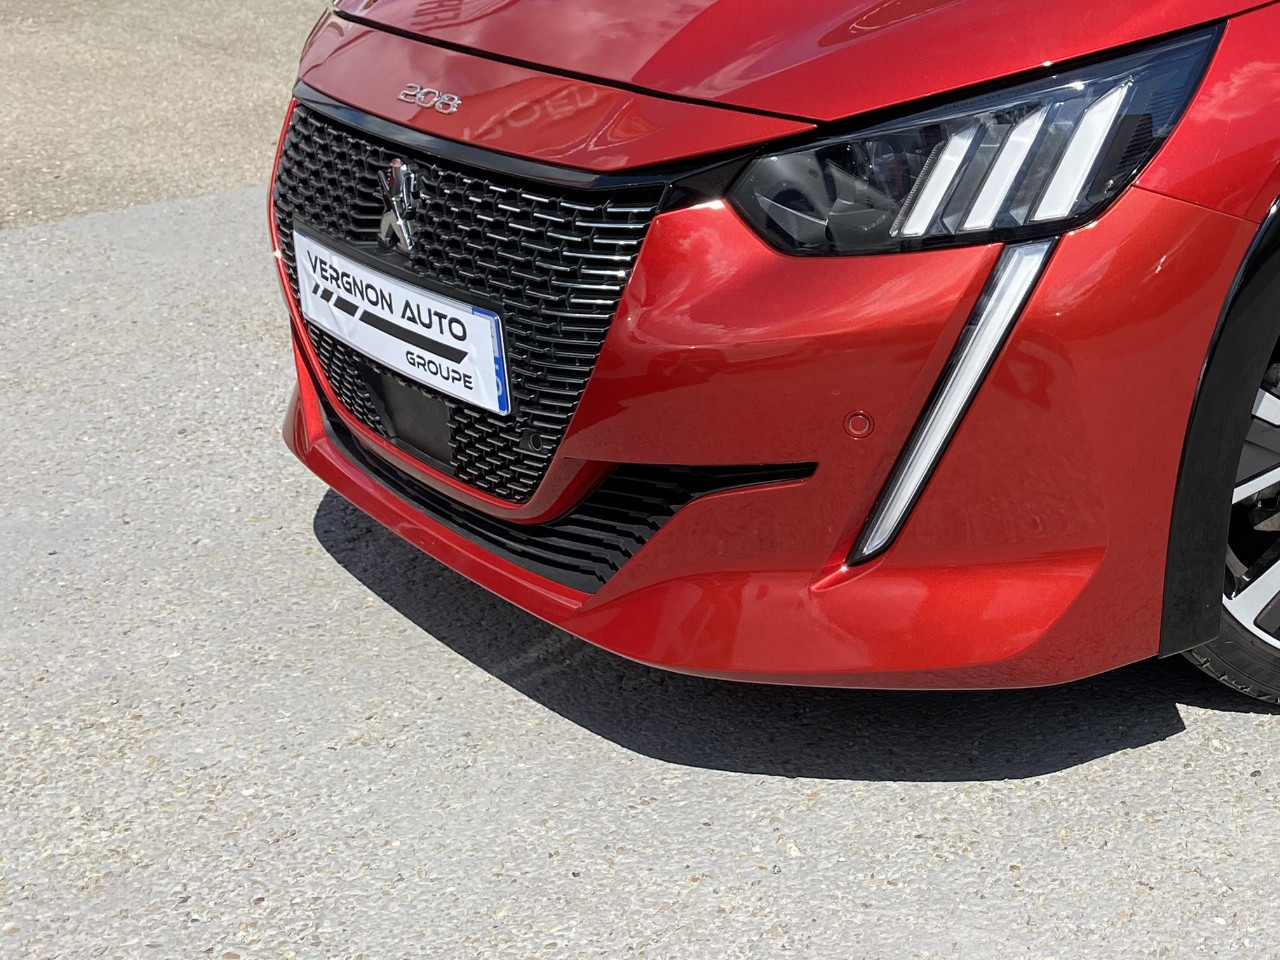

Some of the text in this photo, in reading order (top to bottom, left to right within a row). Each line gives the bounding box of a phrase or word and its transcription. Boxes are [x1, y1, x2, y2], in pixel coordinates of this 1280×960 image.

[397, 83, 462, 115] 208
[307, 250, 467, 341] VERGNON AUTO
[406, 351, 474, 391] GROUPE
